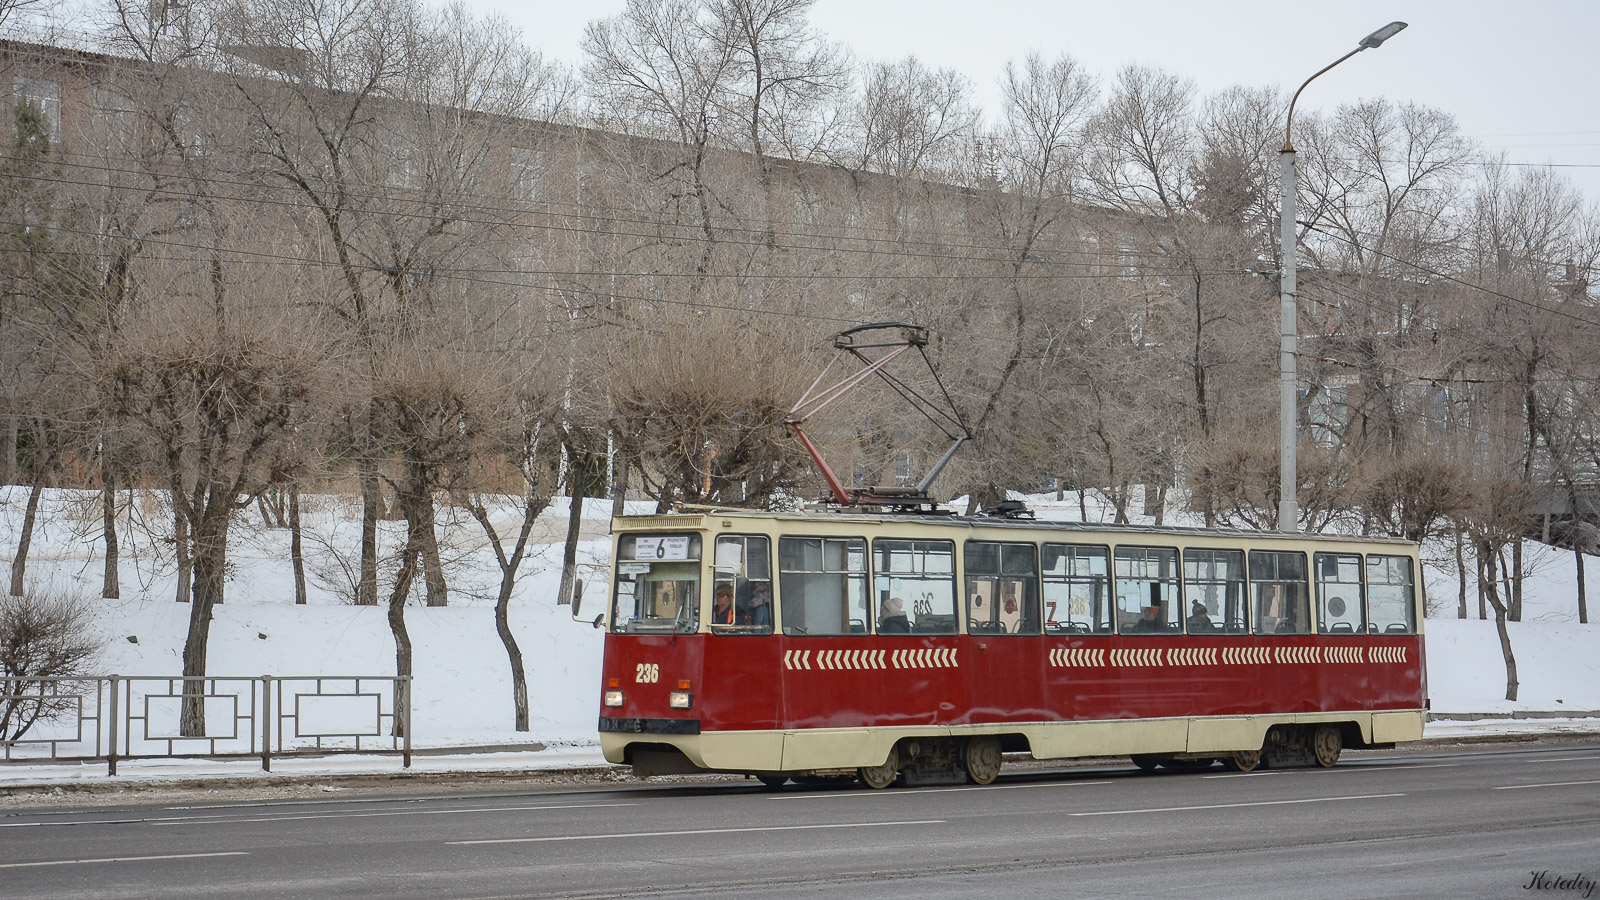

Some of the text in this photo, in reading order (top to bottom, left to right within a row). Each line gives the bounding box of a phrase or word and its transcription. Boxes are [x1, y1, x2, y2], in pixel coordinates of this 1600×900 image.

[656, 538, 665, 559] 6
[1046, 601, 1057, 626] Z
[635, 663, 659, 684] 236
